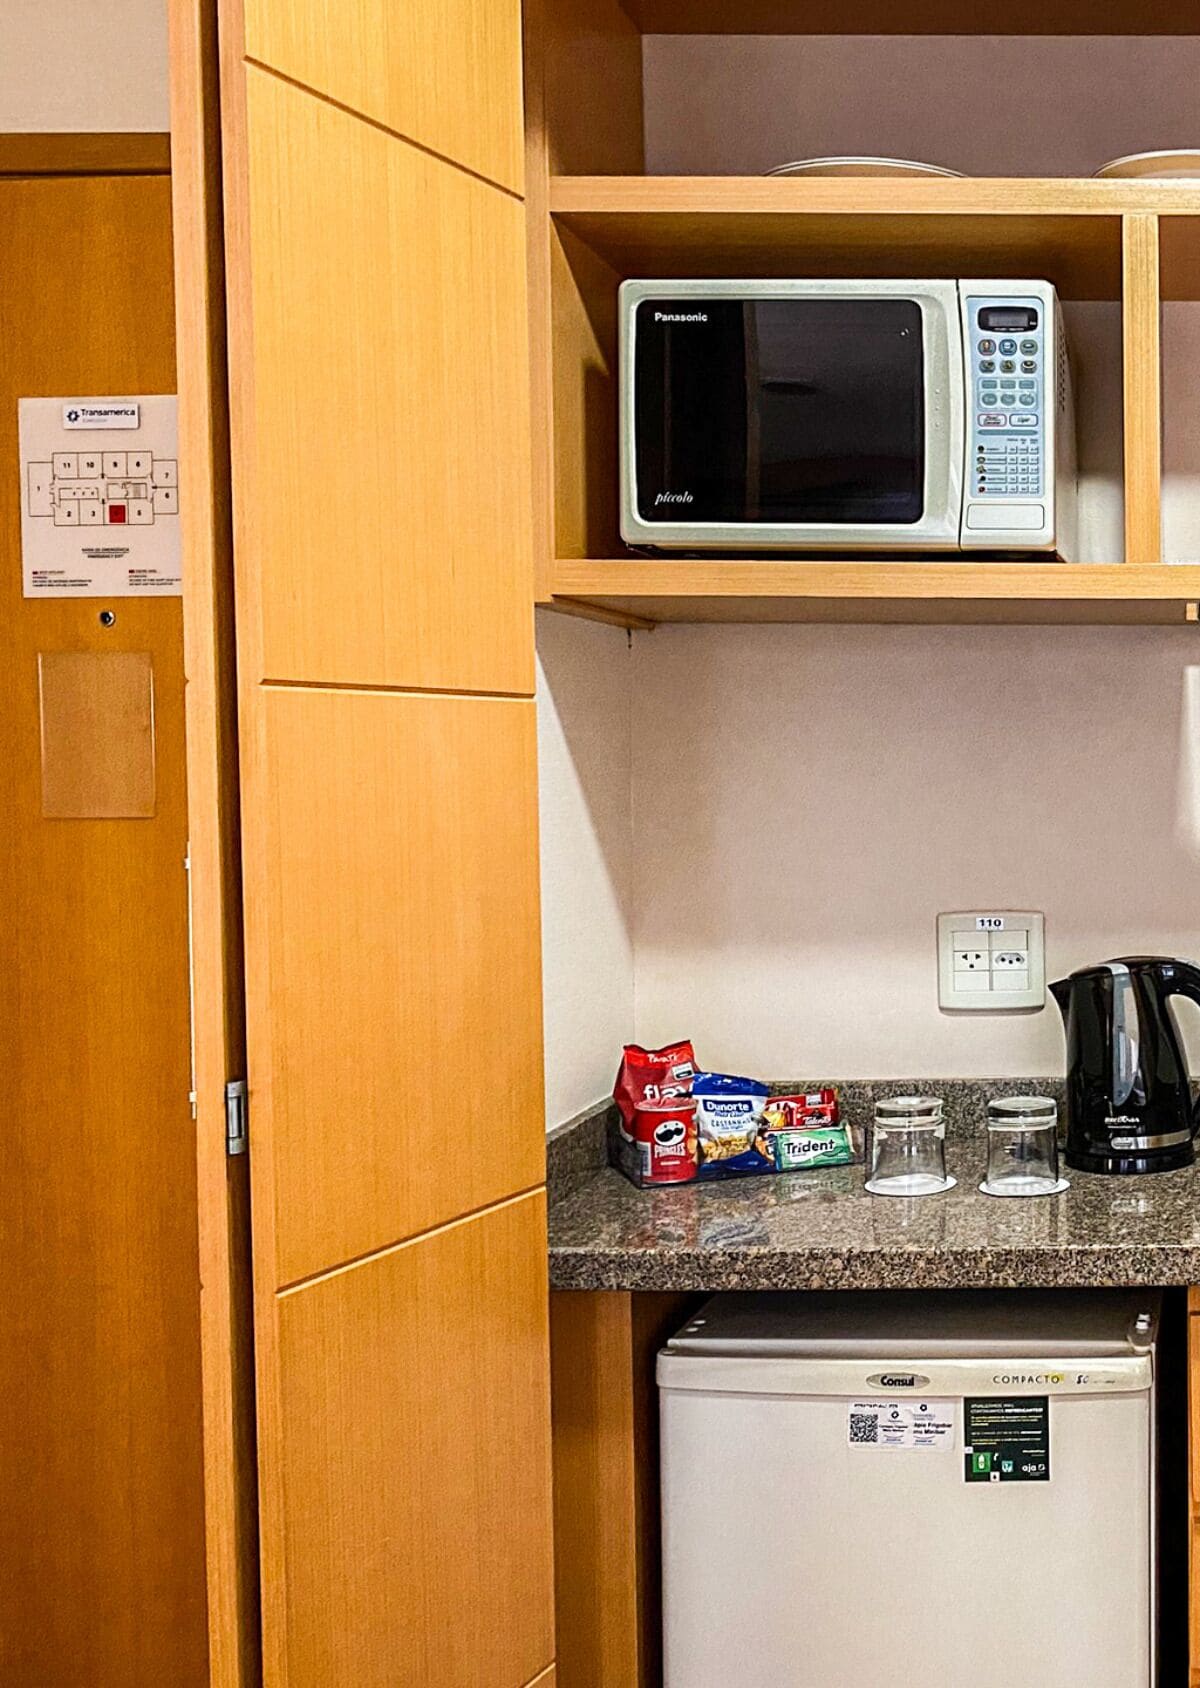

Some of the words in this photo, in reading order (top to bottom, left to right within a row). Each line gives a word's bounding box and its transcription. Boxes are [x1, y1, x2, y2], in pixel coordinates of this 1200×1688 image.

[654, 312, 708, 322] Panasonic
[80, 408, 136, 416] Transamerica
[979, 918, 1002, 927] 110
[706, 1101, 750, 1112] Dunorte
[784, 1139, 835, 1154] Trident
[880, 1375, 915, 1387] Consul
[992, 1375, 1061, 1385] COMPACTO
